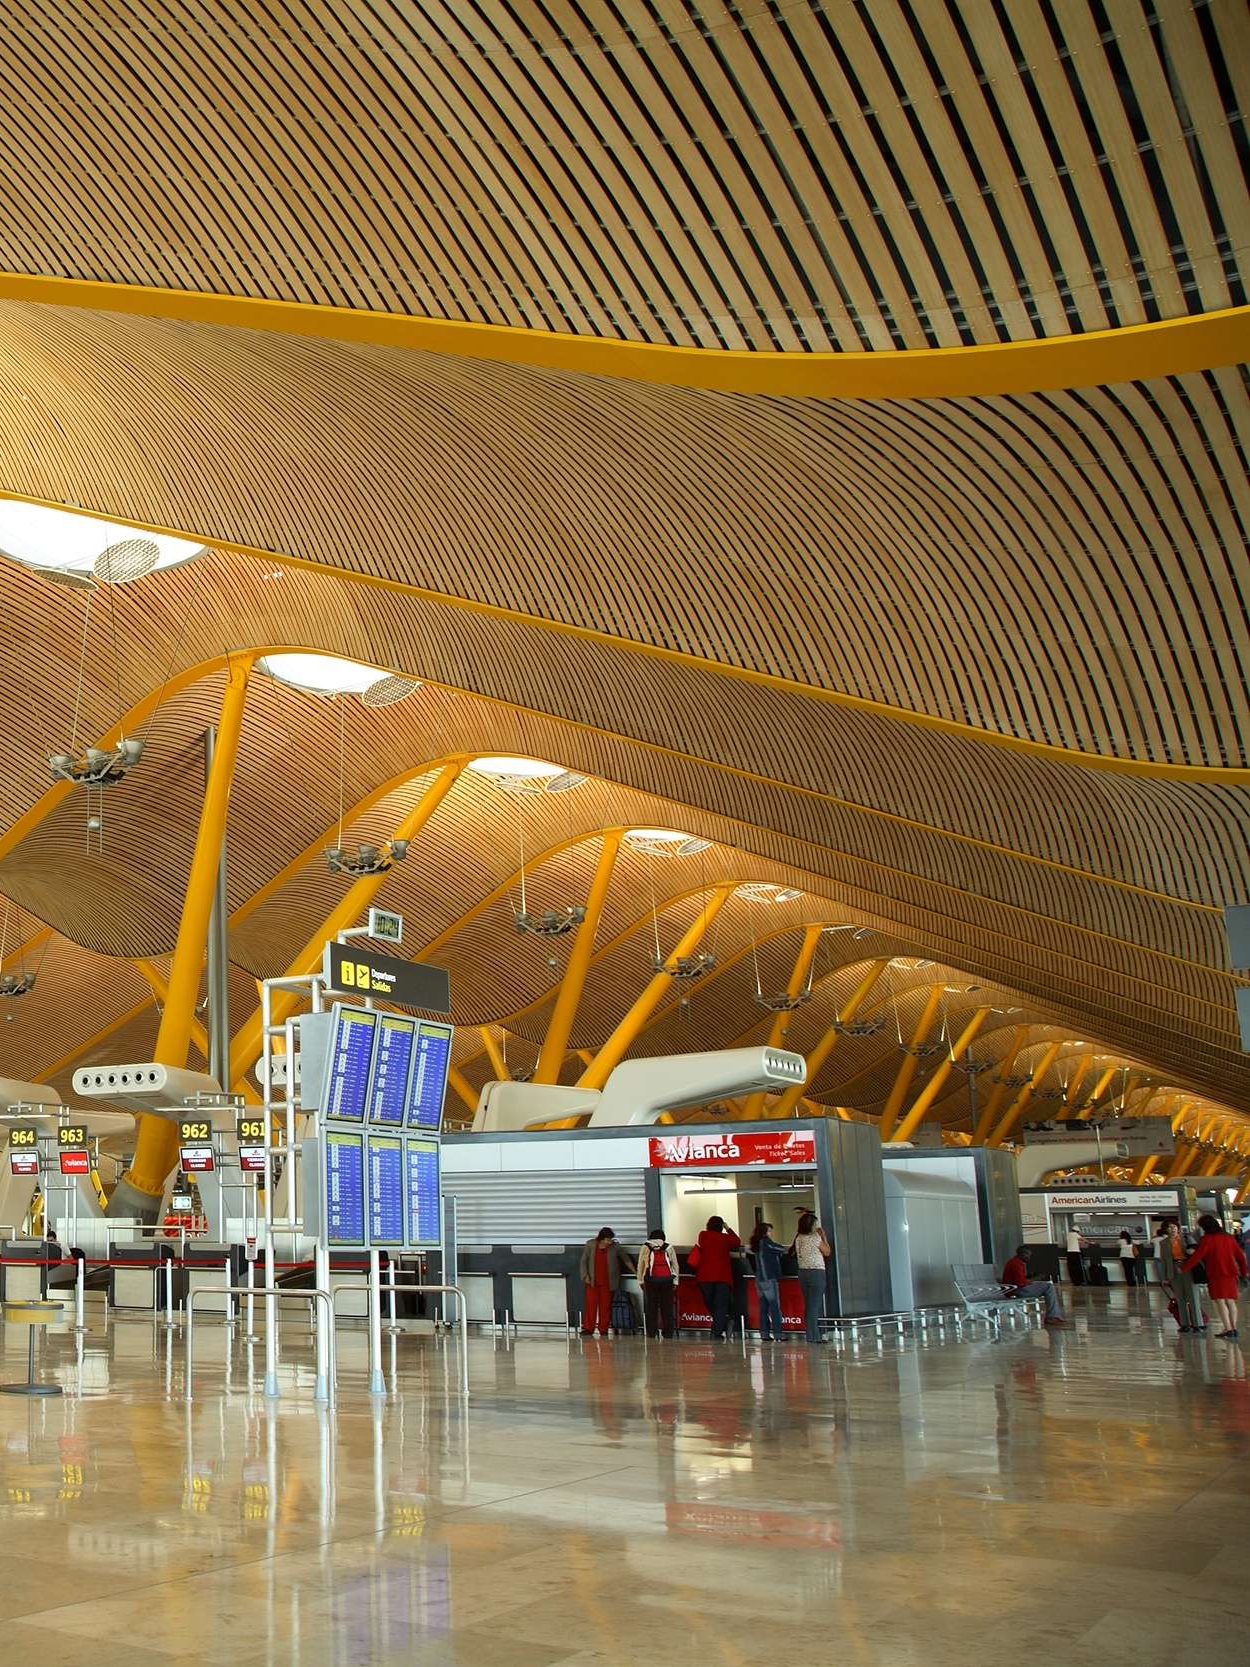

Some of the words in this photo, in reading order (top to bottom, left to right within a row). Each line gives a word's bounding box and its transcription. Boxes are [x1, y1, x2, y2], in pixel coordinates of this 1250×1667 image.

[376, 916, 399, 938] 10:24
[371, 968, 396, 983] Departures
[371, 980, 391, 993] Salidas
[60, 1128, 83, 1143] 963
[182, 1123, 208, 1139] 962
[241, 1121, 265, 1137] 961
[11, 1130, 34, 1144] 964
[665, 1143, 740, 1162] Avianca
[1079, 1224, 1129, 1234] merican
